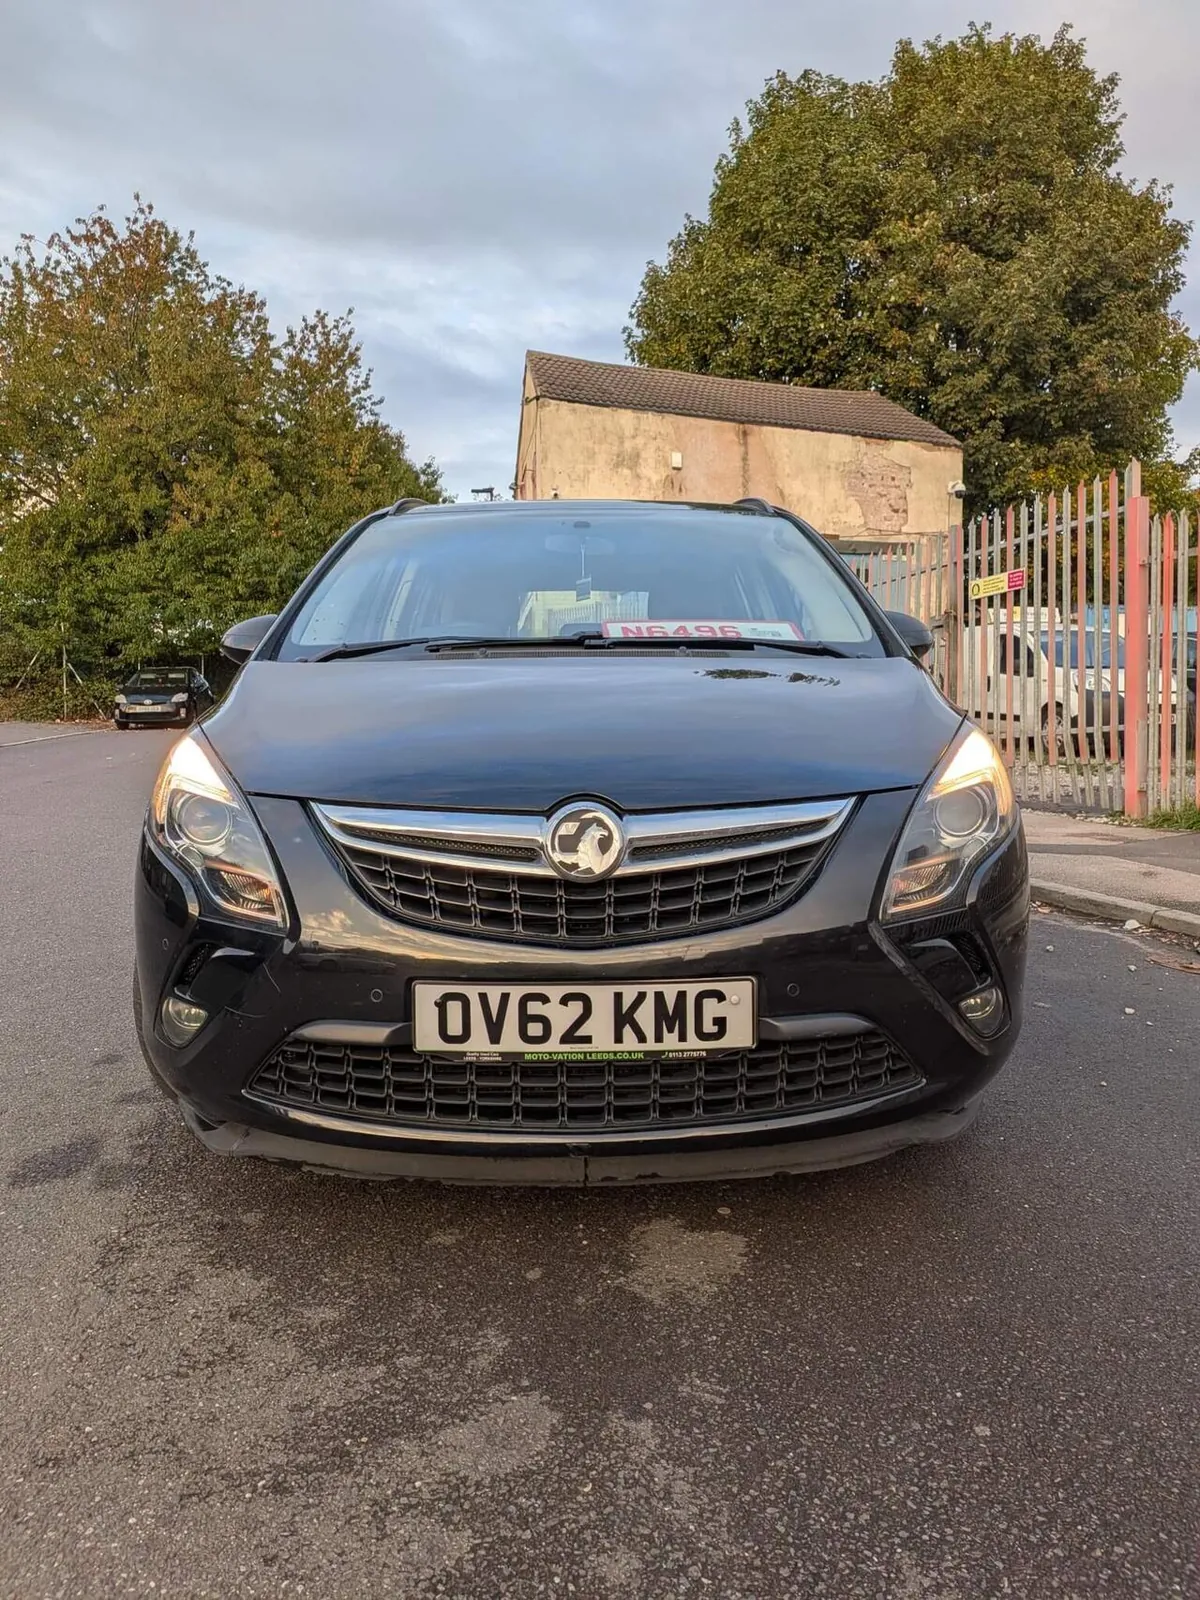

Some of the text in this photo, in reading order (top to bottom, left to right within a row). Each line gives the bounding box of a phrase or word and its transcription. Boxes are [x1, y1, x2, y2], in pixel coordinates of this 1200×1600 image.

[621, 625, 742, 638] N6496
[437, 989, 727, 1045] OV62 KMG
[586, 1052, 645, 1060] LEEDS.CO.UK
